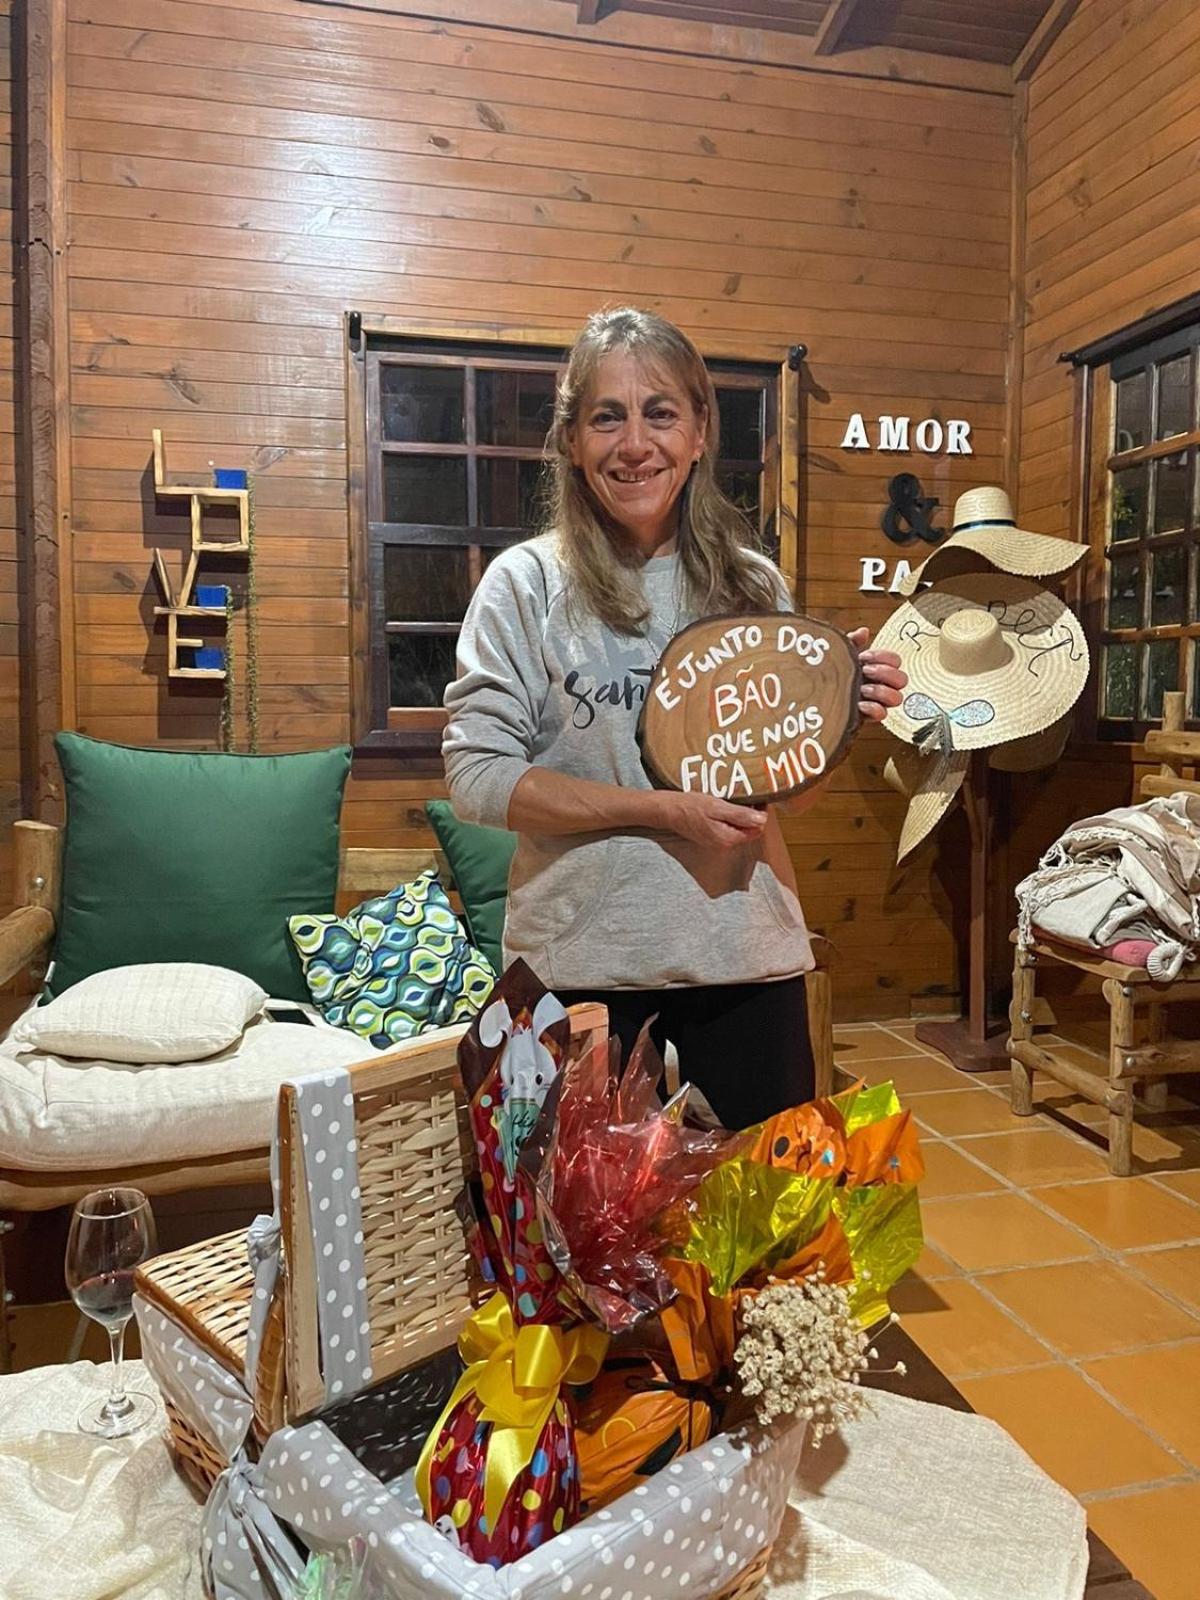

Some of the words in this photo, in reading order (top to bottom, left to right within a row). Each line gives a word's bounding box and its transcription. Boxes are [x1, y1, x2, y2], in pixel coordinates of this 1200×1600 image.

[840, 413, 973, 454] AMOR
[882, 472, 946, 544] &
[859, 557, 934, 593] PA
[654, 666, 681, 711] É
[677, 625, 763, 689] JUNTO
[777, 625, 830, 666] DOS
[714, 663, 782, 728] BÃO
[706, 728, 756, 759] QUE
[762, 702, 824, 747] NÓIS
[680, 754, 753, 799] FICA
[766, 731, 826, 793] MIÓ
